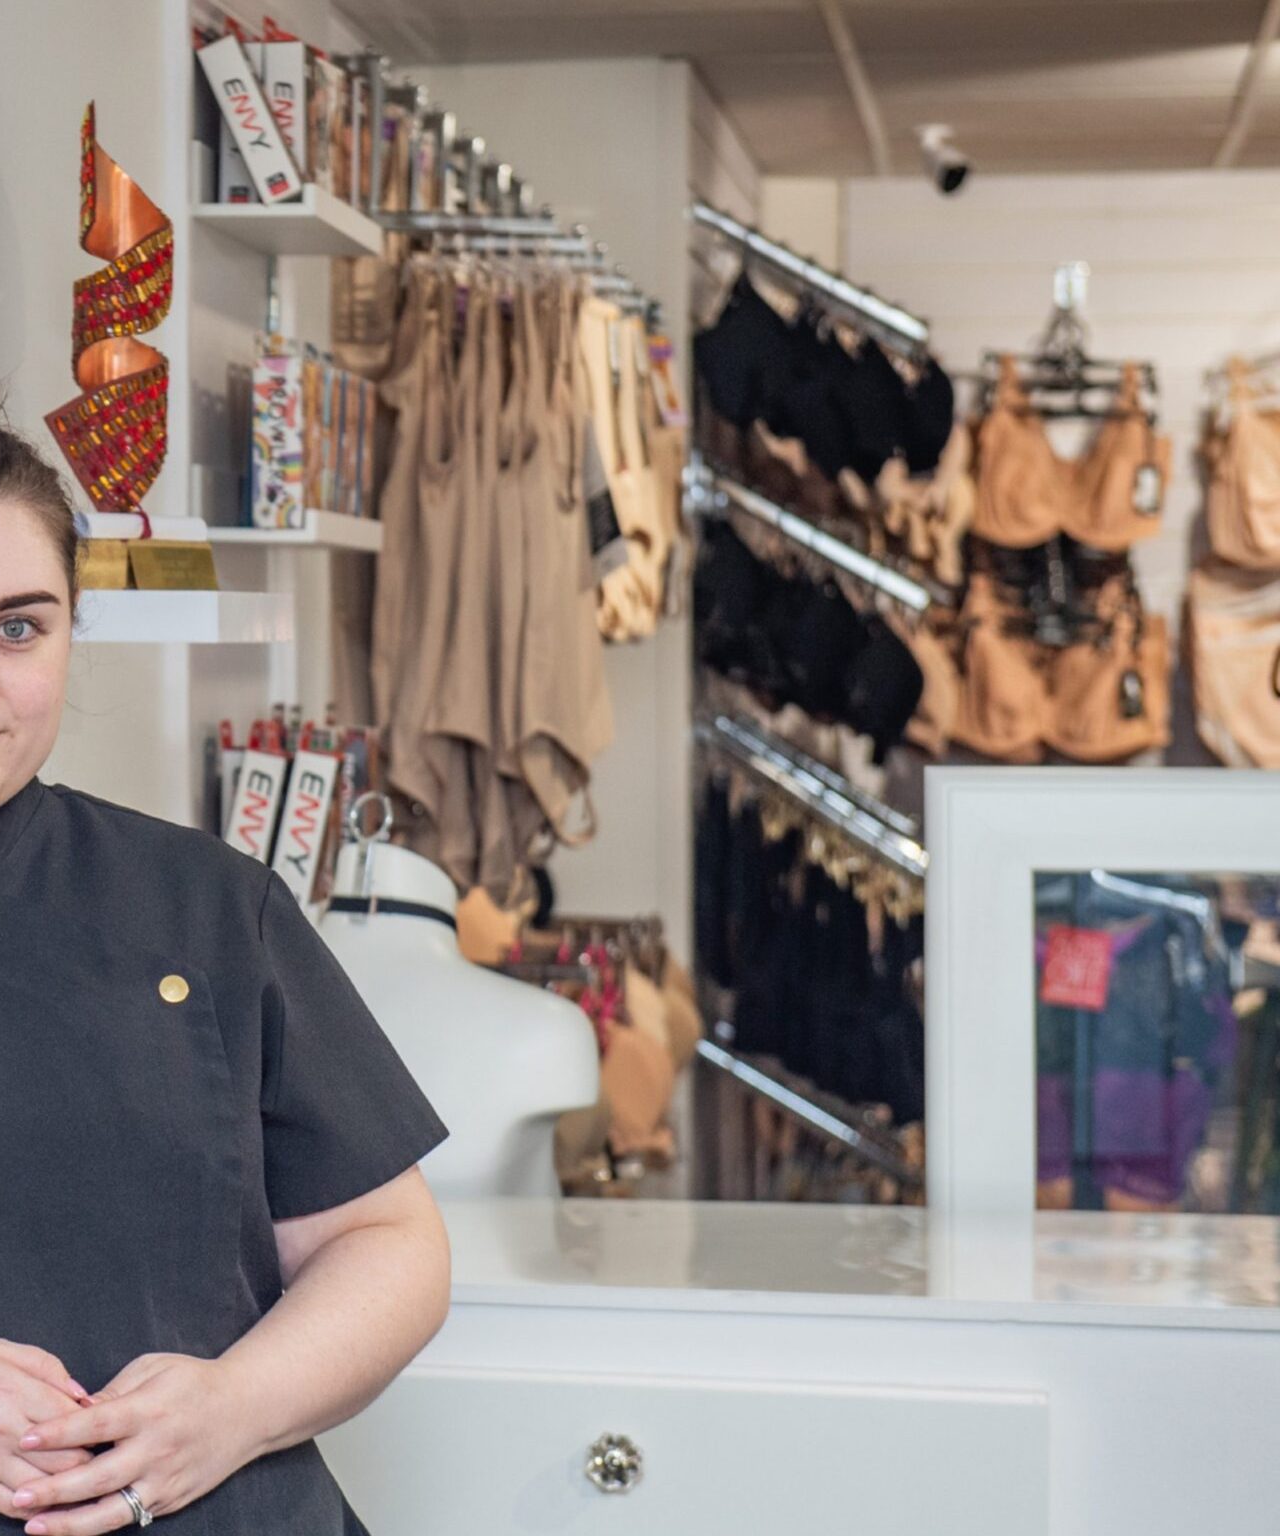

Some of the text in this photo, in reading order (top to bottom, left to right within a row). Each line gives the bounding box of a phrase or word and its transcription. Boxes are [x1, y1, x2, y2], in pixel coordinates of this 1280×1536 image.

[223, 78, 272, 149] ENVY
[238, 769, 273, 857] ENV
[286, 770, 325, 877] ENVY
